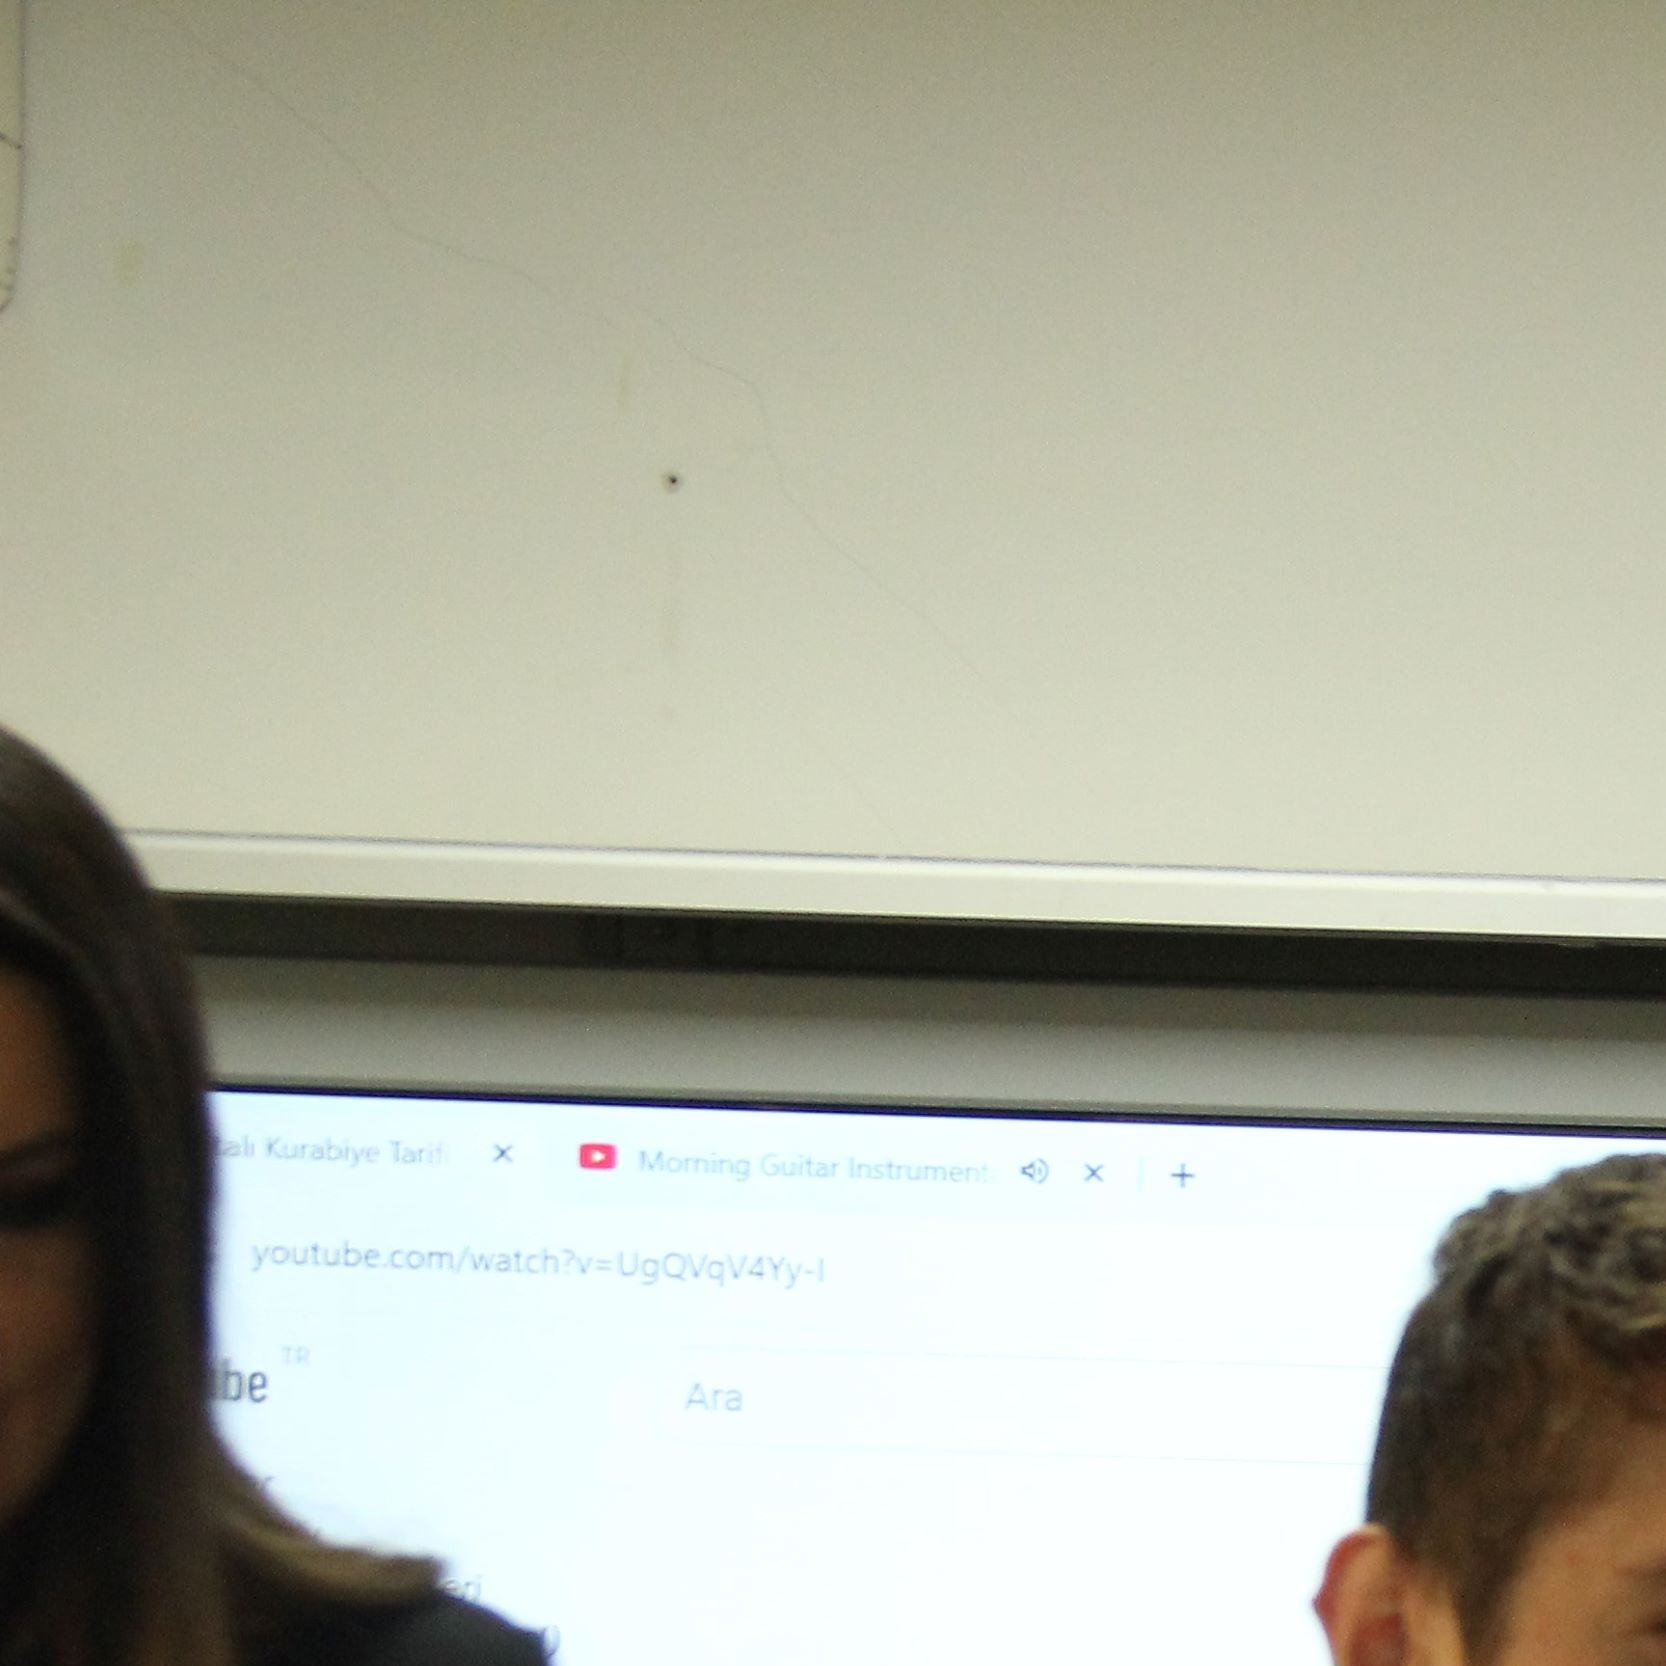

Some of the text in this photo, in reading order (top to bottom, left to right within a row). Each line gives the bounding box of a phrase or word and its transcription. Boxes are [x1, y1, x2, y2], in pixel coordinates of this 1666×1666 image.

[265, 1136, 381, 1168] Kurabiye
[638, 1150, 751, 1185] Morning
[759, 1153, 840, 1179] Guitar
[683, 1383, 743, 1413] Ara
